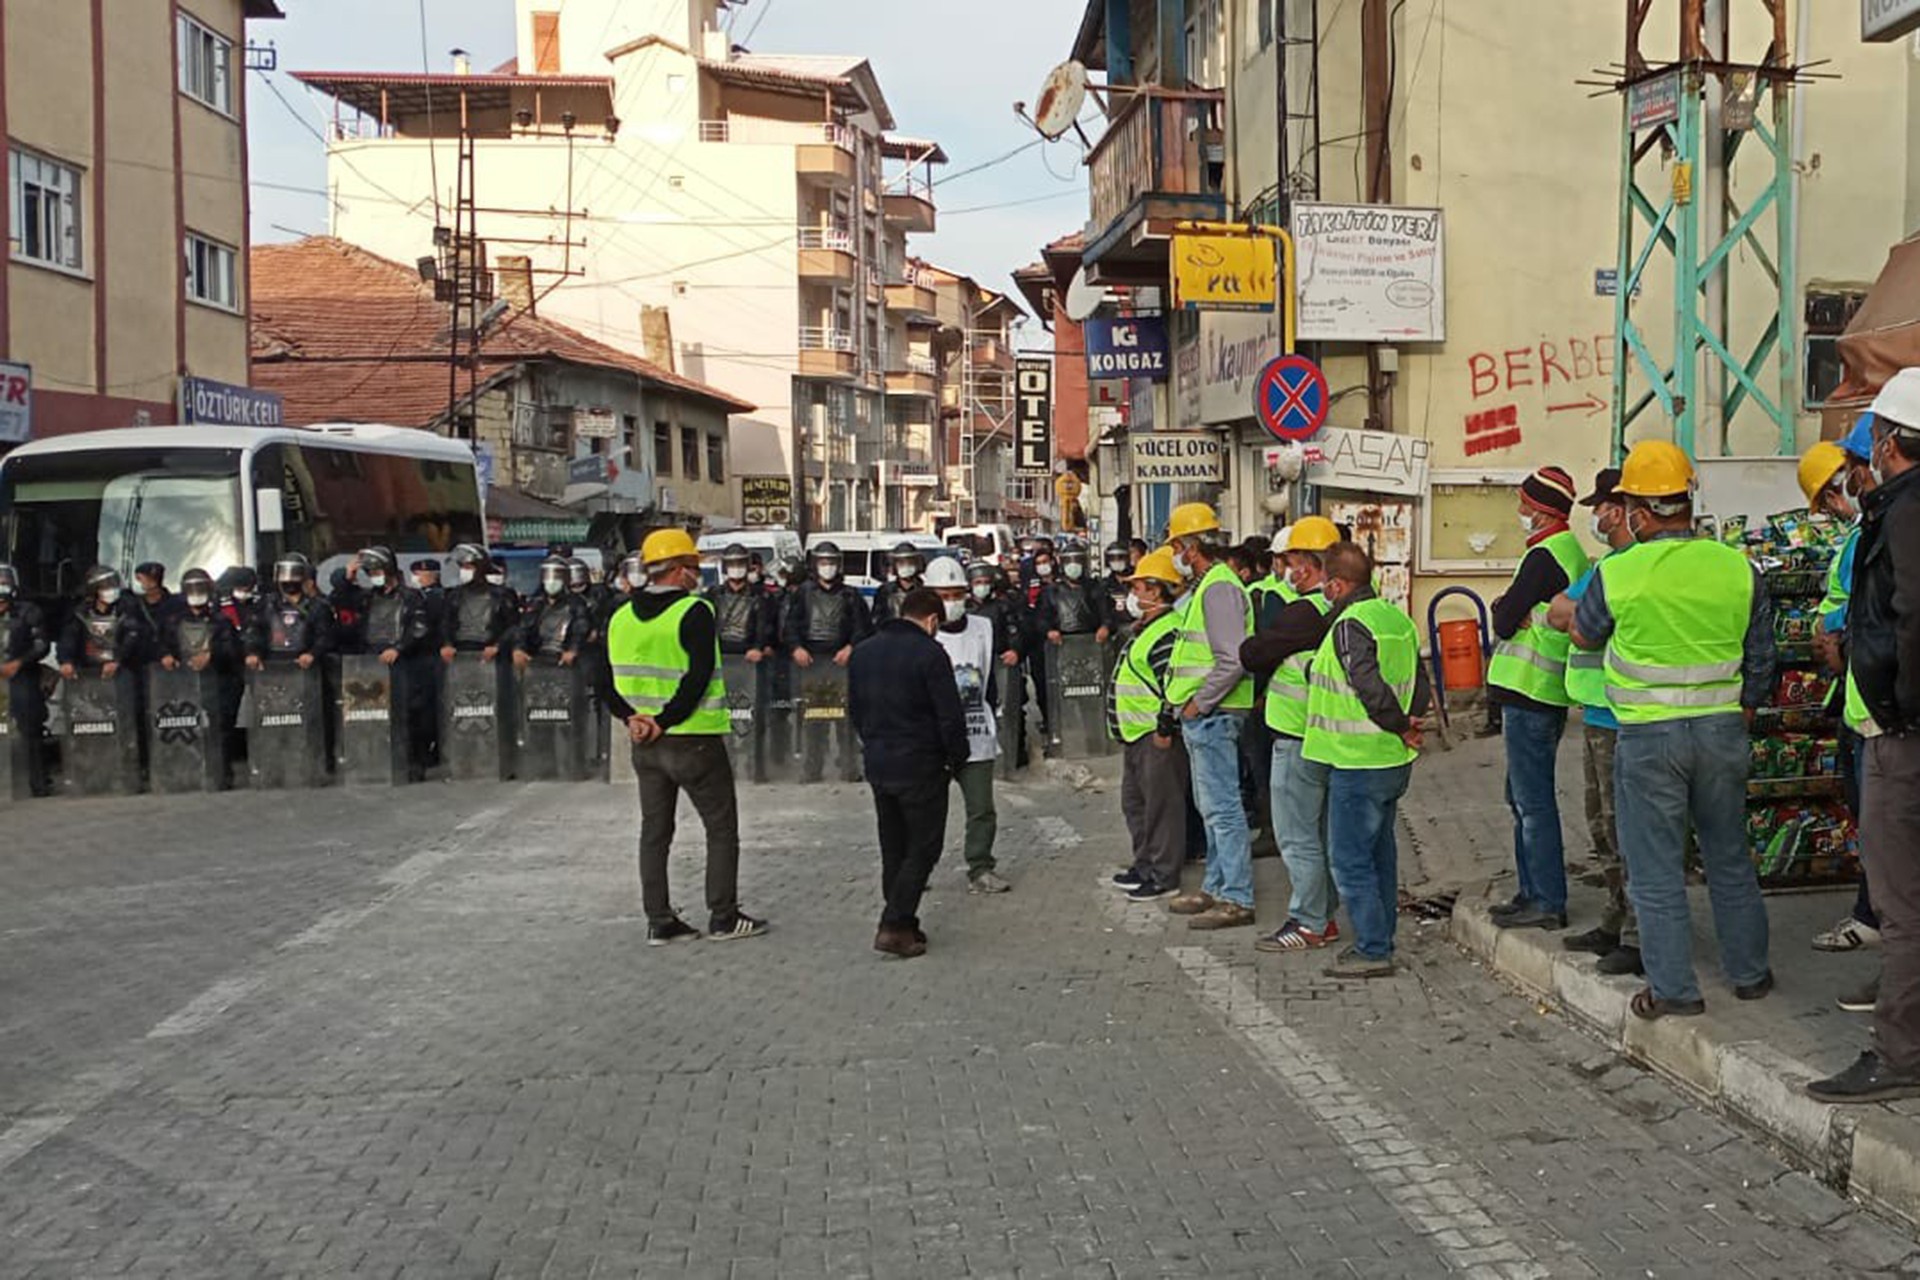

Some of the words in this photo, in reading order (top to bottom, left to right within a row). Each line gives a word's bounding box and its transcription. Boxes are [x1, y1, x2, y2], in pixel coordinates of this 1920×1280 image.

[1391, 213, 1439, 242] YERİ
[1090, 350, 1163, 372] KONGAZ
[1019, 371, 1047, 467] OTEL
[1135, 438, 1183, 457] YÜCEL
[1187, 440, 1218, 457] OTO
[1137, 464, 1219, 478] KARAMAN
